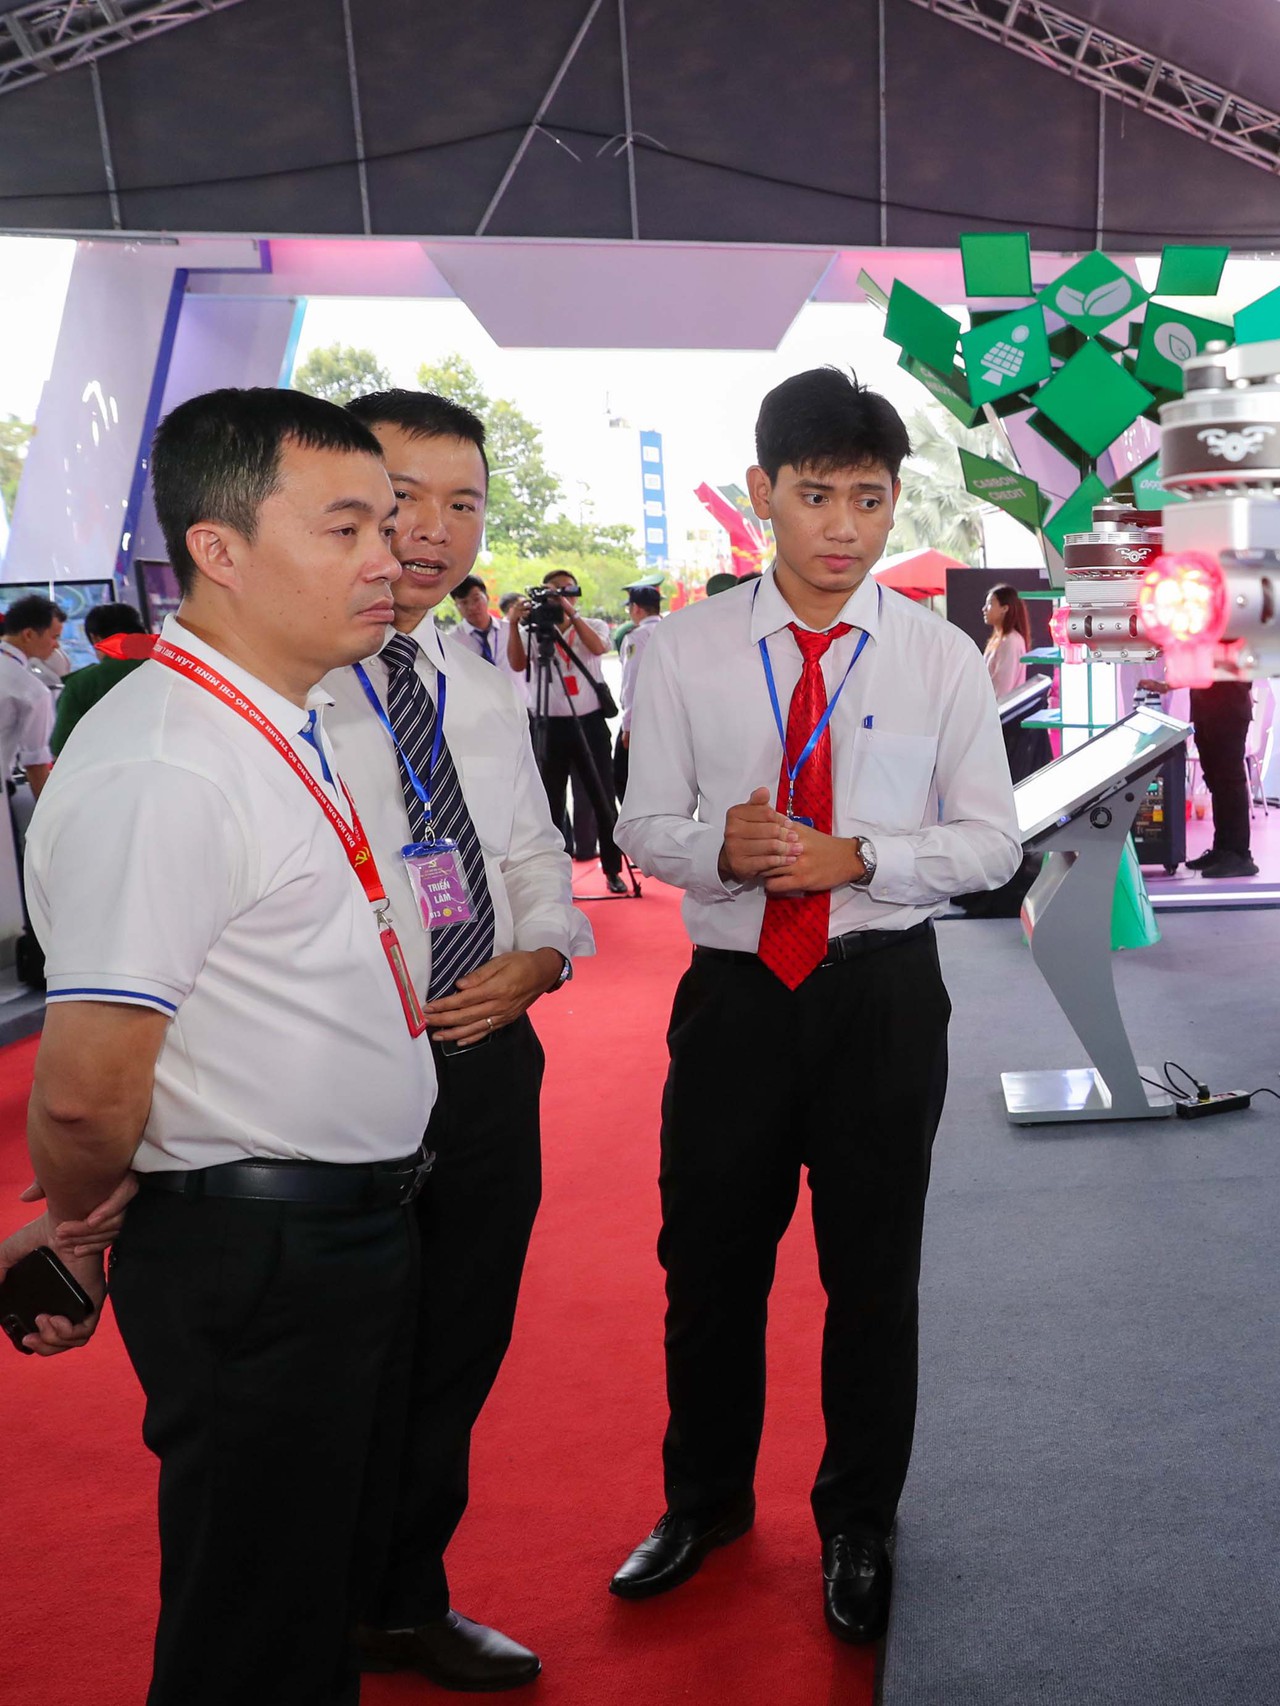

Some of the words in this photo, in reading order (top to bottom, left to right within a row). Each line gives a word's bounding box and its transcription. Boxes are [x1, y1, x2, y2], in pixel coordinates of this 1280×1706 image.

[972, 475, 1018, 489] CARBON
[988, 488, 1026, 500] CREDIT
[175, 655, 195, 669] LẦN
[194, 667, 220, 686] MINH
[219, 684, 236, 699] CHÍ
[234, 698, 249, 711] HỒ
[248, 709, 265, 726] PHỐ
[265, 725, 289, 752] THÀNH
[288, 751, 298, 763] BỘ
[297, 763, 315, 786] ĐẢNG
[336, 819, 347, 833] HỘI
[345, 833, 356, 848] ĐẠI
[427, 878, 450, 892] TRIỂN
